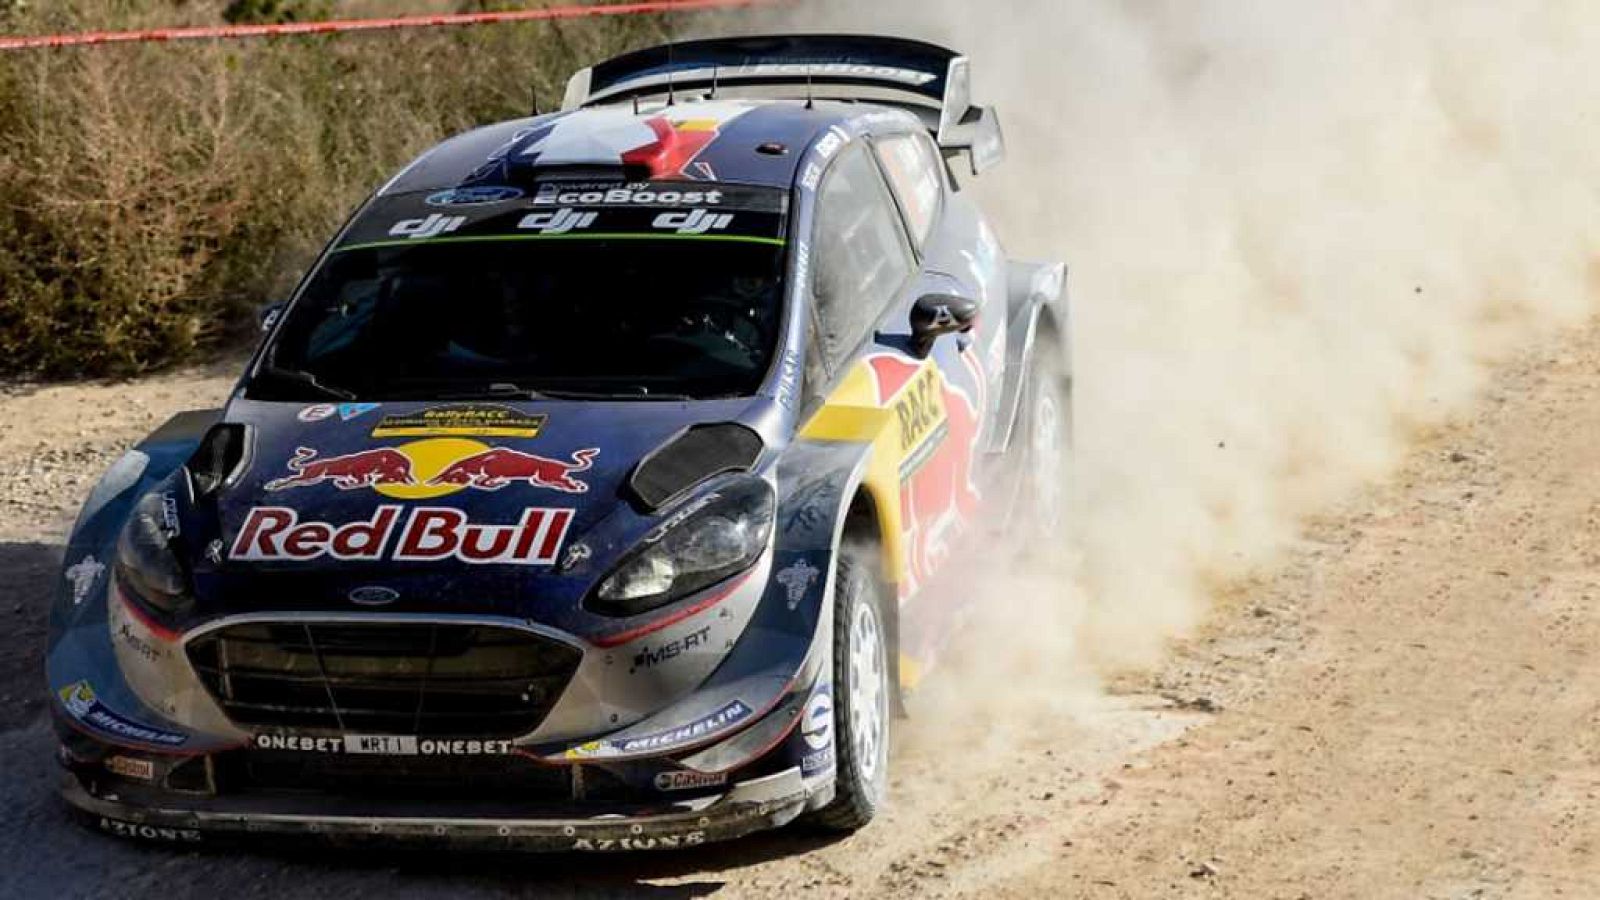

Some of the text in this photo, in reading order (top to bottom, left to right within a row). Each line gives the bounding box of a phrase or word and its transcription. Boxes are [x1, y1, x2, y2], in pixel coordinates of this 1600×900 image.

[625, 182, 649, 191] by
[533, 189, 723, 205] EcoBoost
[228, 505, 575, 565] Red Bull
[624, 703, 745, 750] MICHELIN
[257, 735, 343, 752] ONEBET
[420, 740, 513, 755] ONEBET
